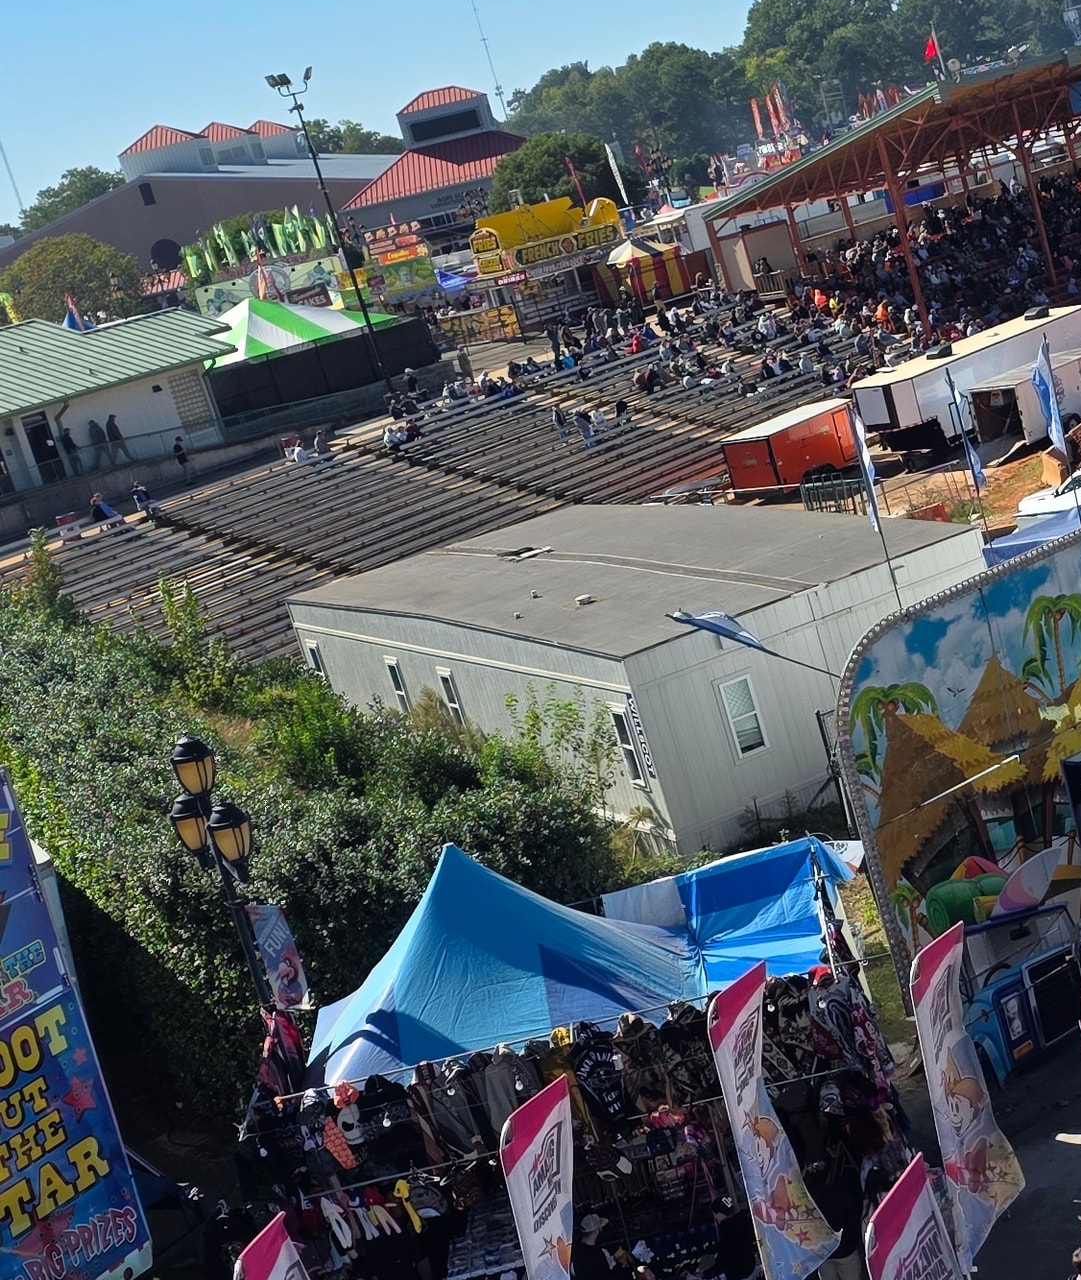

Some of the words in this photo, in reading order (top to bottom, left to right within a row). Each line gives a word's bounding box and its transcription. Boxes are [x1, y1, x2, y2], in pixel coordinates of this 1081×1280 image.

[473, 238, 497, 252] FRIES
[522, 244, 560, 264] FRENCH
[577, 225, 615, 249] FRIES
[2, 941, 45, 978] THE
[63, 1206, 137, 1267] PRIZES
